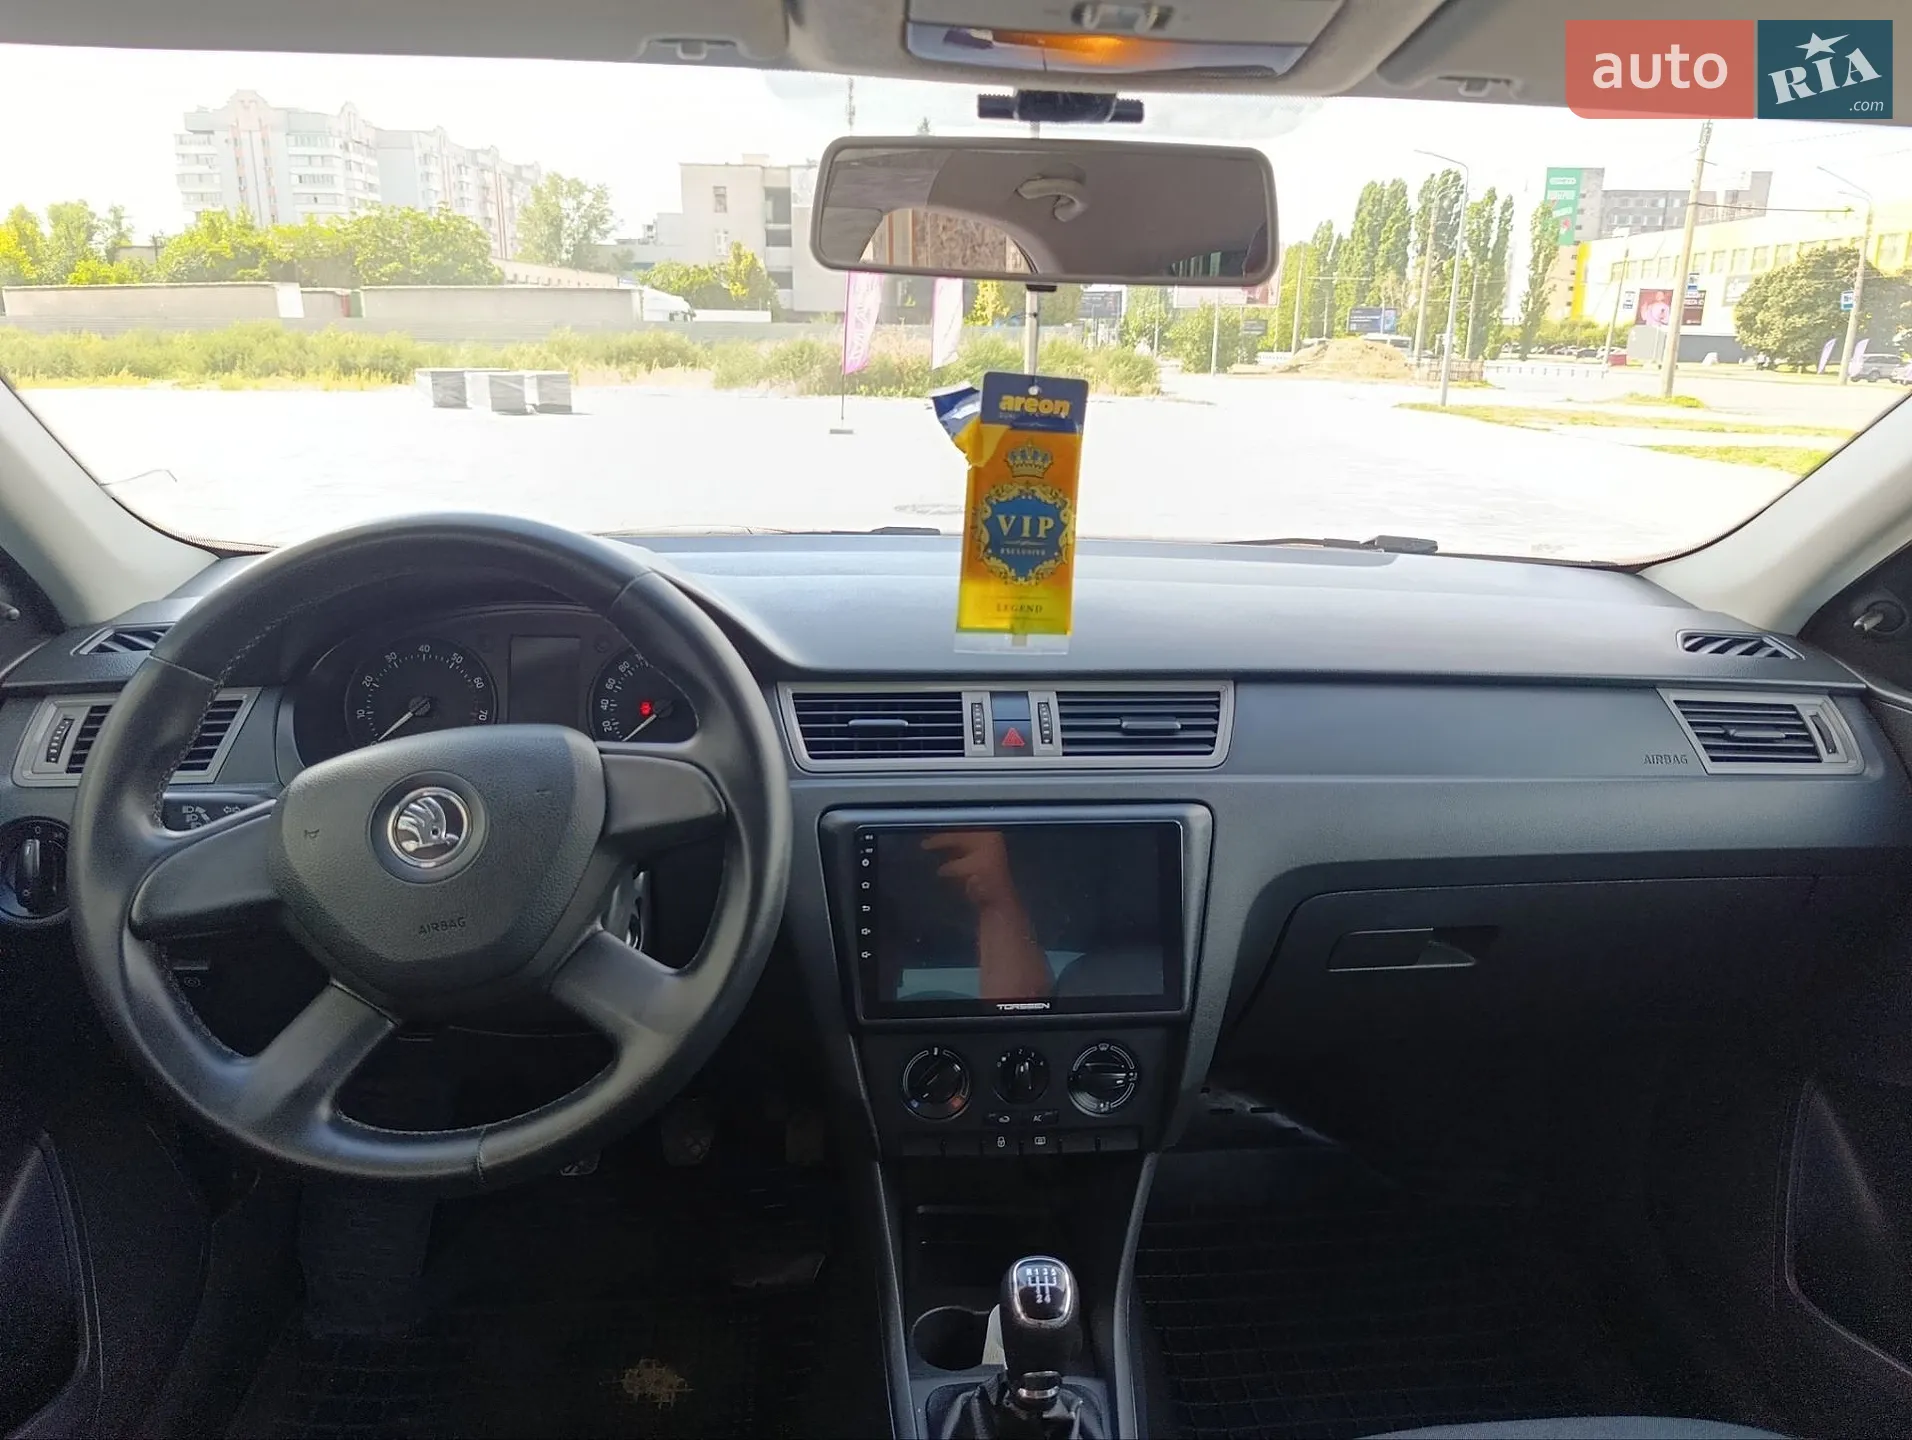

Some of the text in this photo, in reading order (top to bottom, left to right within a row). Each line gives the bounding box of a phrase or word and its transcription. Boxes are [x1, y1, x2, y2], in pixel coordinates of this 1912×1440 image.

[999, 395, 1070, 417] areon
[997, 514, 1055, 538] VIP
[996, 603, 1043, 613] LEGEND
[418, 645, 431, 653] 40
[384, 652, 398, 663] 30
[451, 652, 464, 664] 50
[618, 660, 630, 672] 80
[362, 675, 373, 687] 20
[473, 676, 485, 689] 60
[605, 678, 616, 690] 60
[600, 699, 609, 710] 40
[356, 709, 366, 719] 10
[478, 709, 488, 721] 70
[602, 720, 612, 732] 20
[1643, 754, 1688, 764] AIRBAG
[418, 917, 466, 935] AIRBAG
